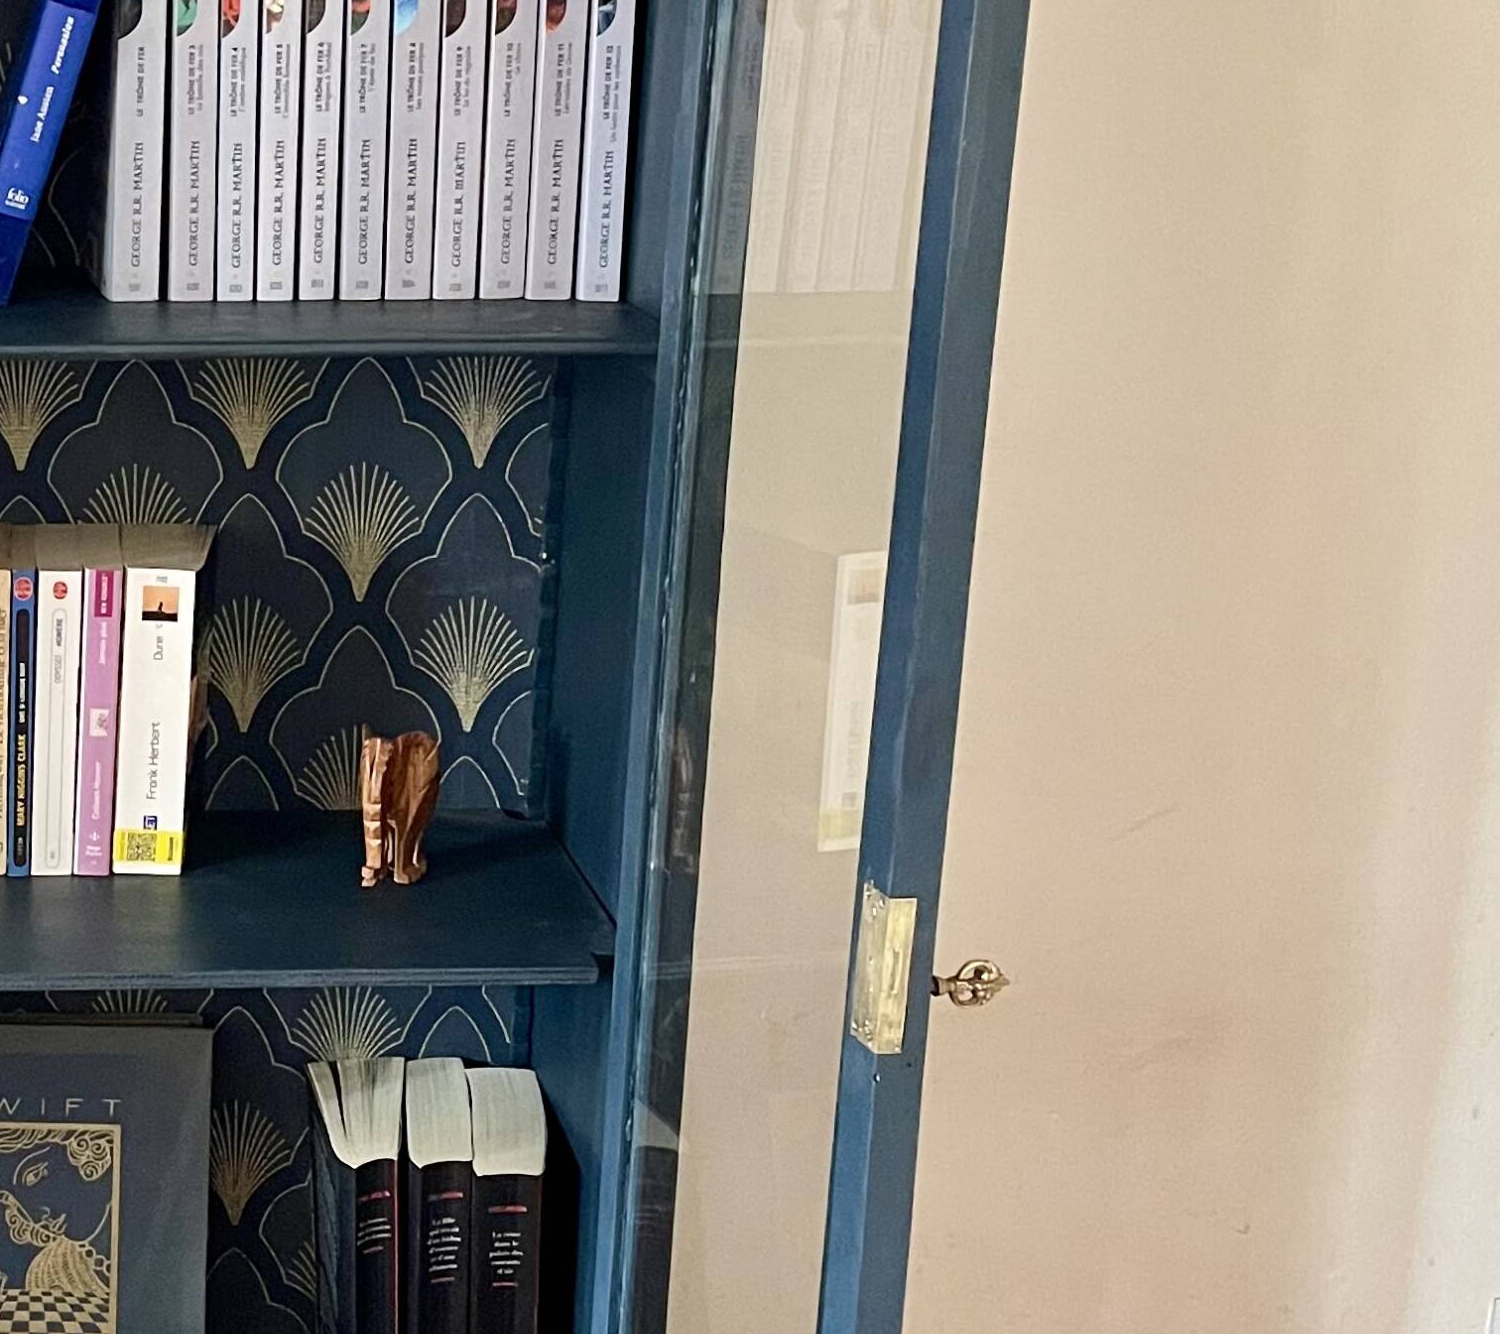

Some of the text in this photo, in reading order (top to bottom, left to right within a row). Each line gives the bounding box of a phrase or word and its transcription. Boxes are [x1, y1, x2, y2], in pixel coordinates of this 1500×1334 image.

[51, 15, 74, 74] Persuasion
[31, 85, 53, 142] Jane Austen
[132, 142, 143, 190] MARTIN
[189, 140, 200, 188] MARTIN
[231, 143, 242, 191] MARTIN
[273, 140, 284, 188] MARTIN
[315, 137, 326, 186] MARTIN
[360, 138, 370, 187] MARTIN
[406, 138, 417, 186] MARTIN
[454, 141, 465, 190] MARTIN
[504, 138, 515, 187] MARTIN
[551, 139, 563, 187] MARTIN
[602, 150, 614, 195] MARTIN
[130, 219, 141, 267] GEORGE
[188, 217, 198, 266] GEORGE
[230, 219, 241, 268] GEORGE
[271, 217, 282, 265] GEORGE
[313, 214, 324, 263] GEORGE
[357, 215, 368, 264] GEORGE
[404, 215, 415, 263] GEORGE
[451, 218, 462, 267] GEORGE
[500, 215, 511, 264] GEORGE
[547, 217, 558, 264] GEORGE
[598, 222, 610, 267] GEORGE
[152, 635, 163, 660] Dune
[16, 734, 26, 761] CLARK
[146, 721, 160, 799] Frank Herbert
[15, 801, 25, 825] MARY
